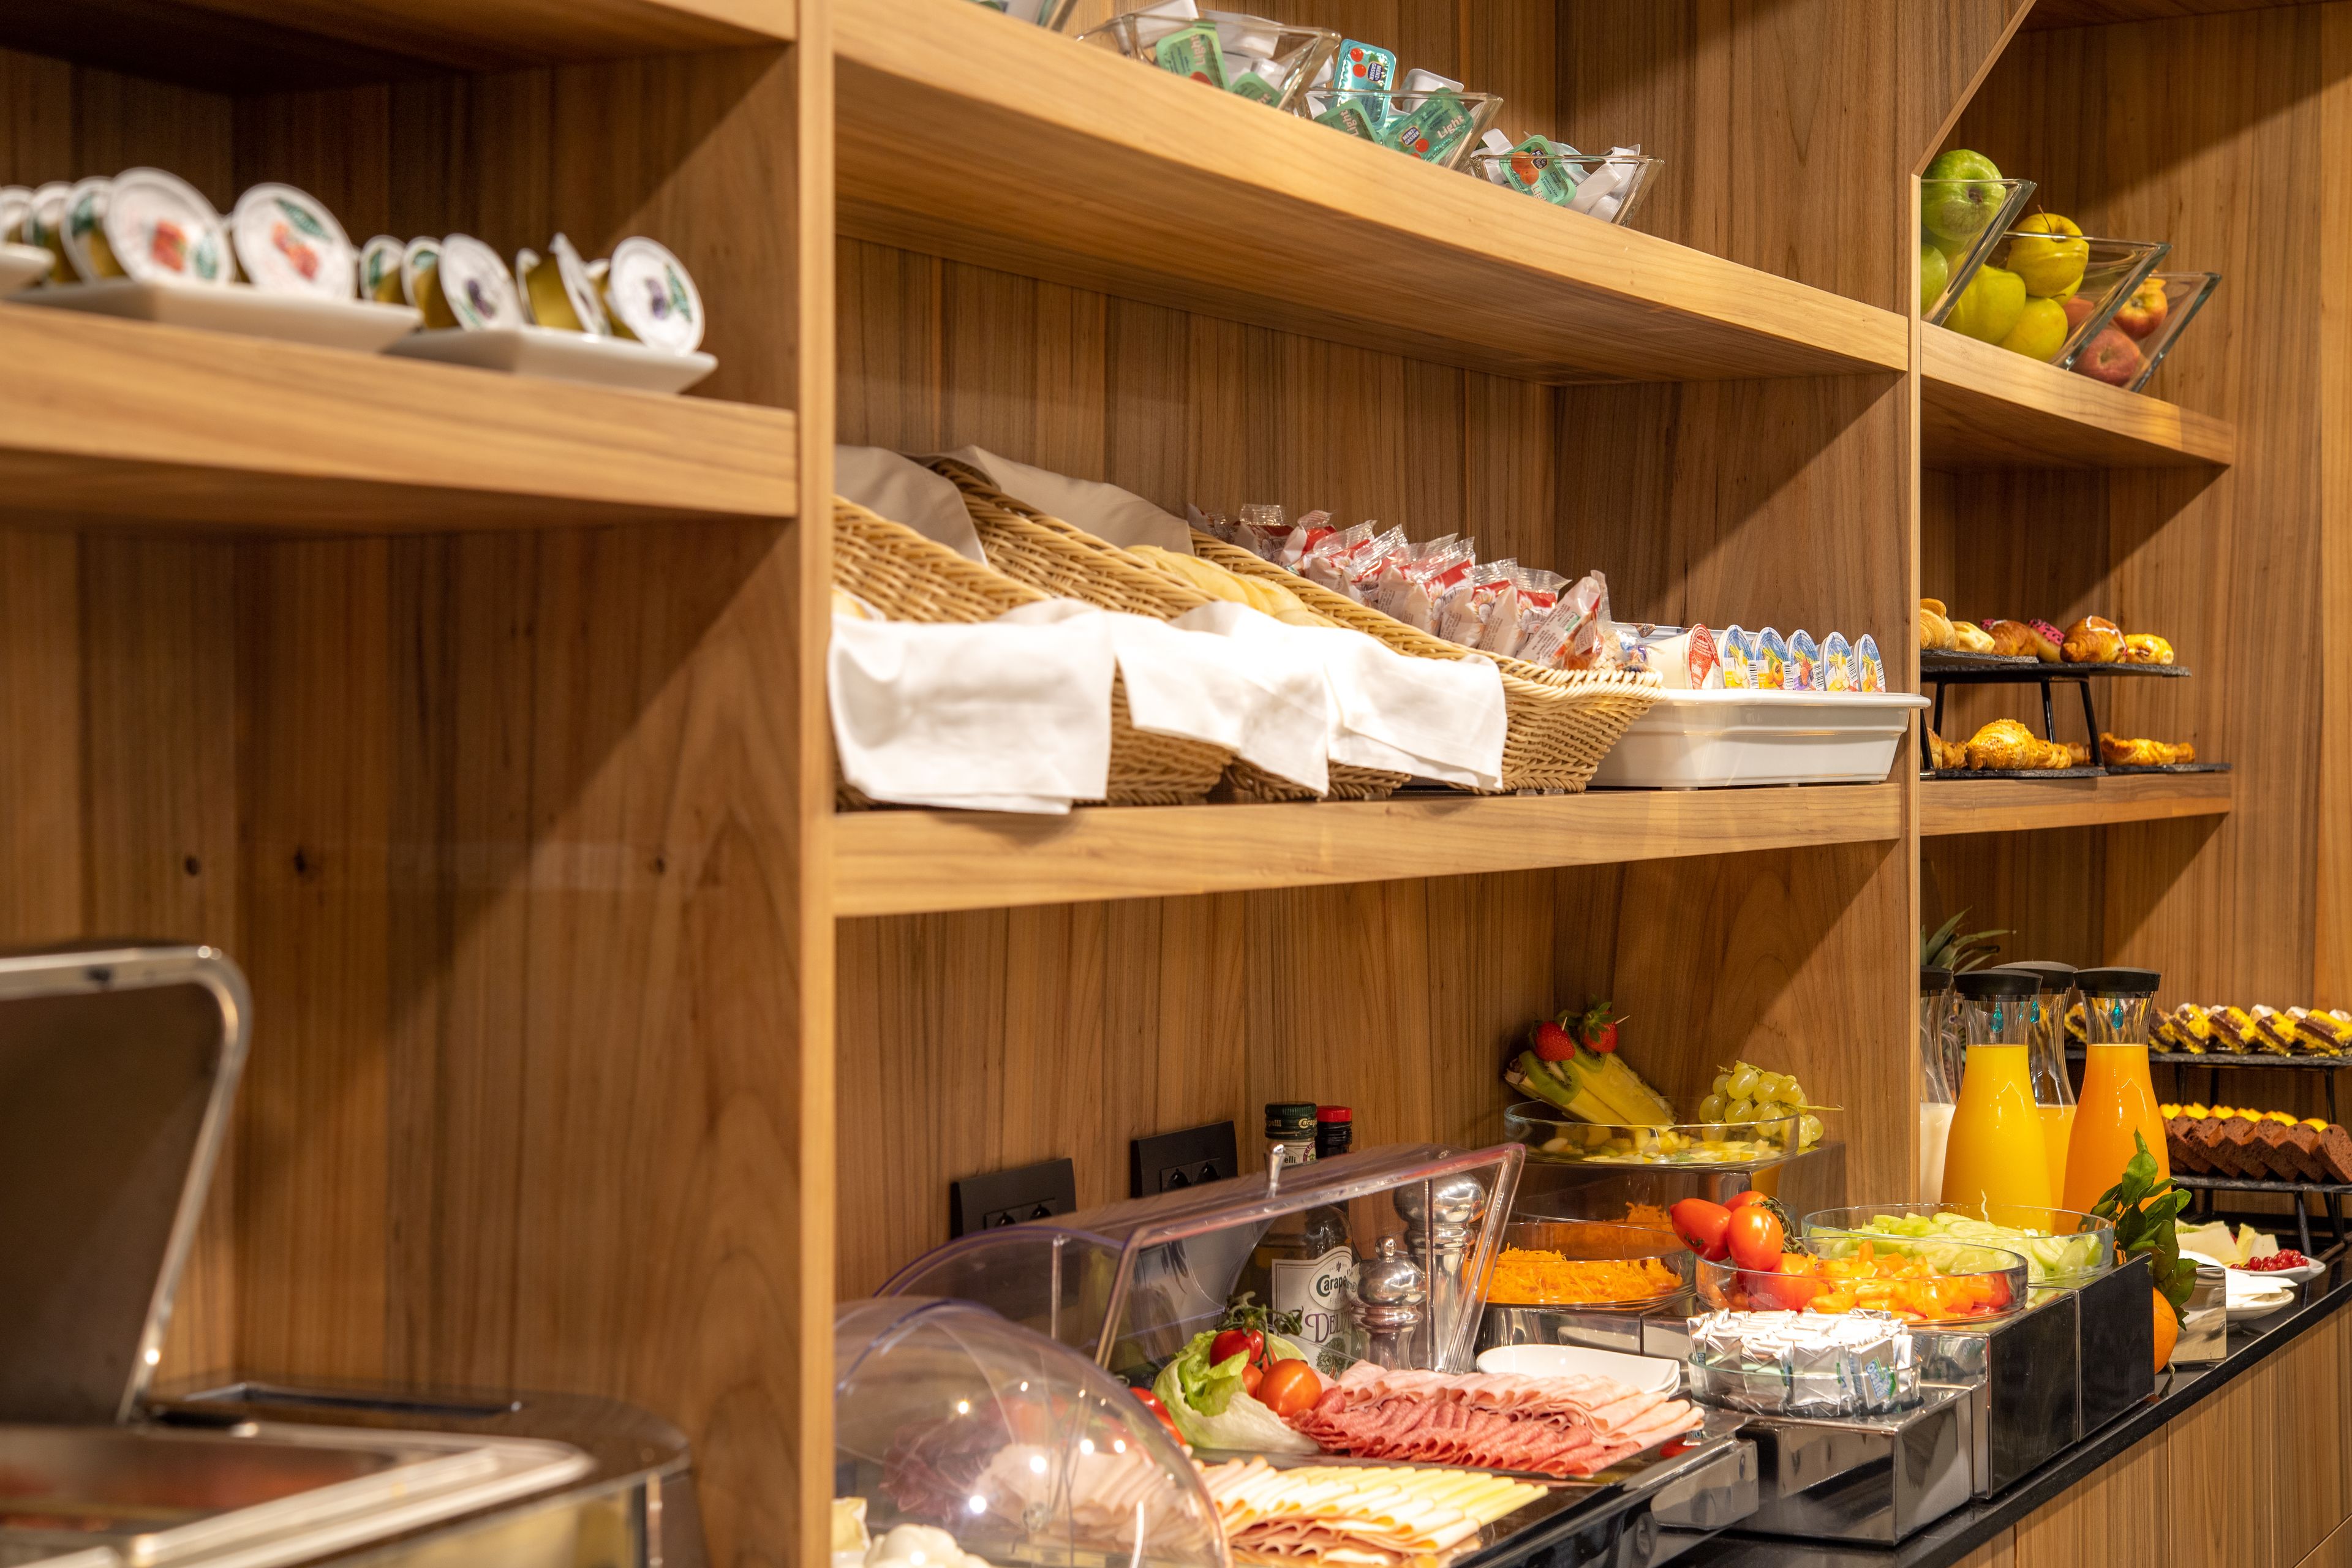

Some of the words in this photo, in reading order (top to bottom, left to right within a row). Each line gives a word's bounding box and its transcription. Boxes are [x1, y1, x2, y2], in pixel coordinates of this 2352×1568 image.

[1404, 130, 1420, 145] GASSER
[1437, 115, 1465, 139] Light
[1316, 1274, 1348, 1297] Carape
